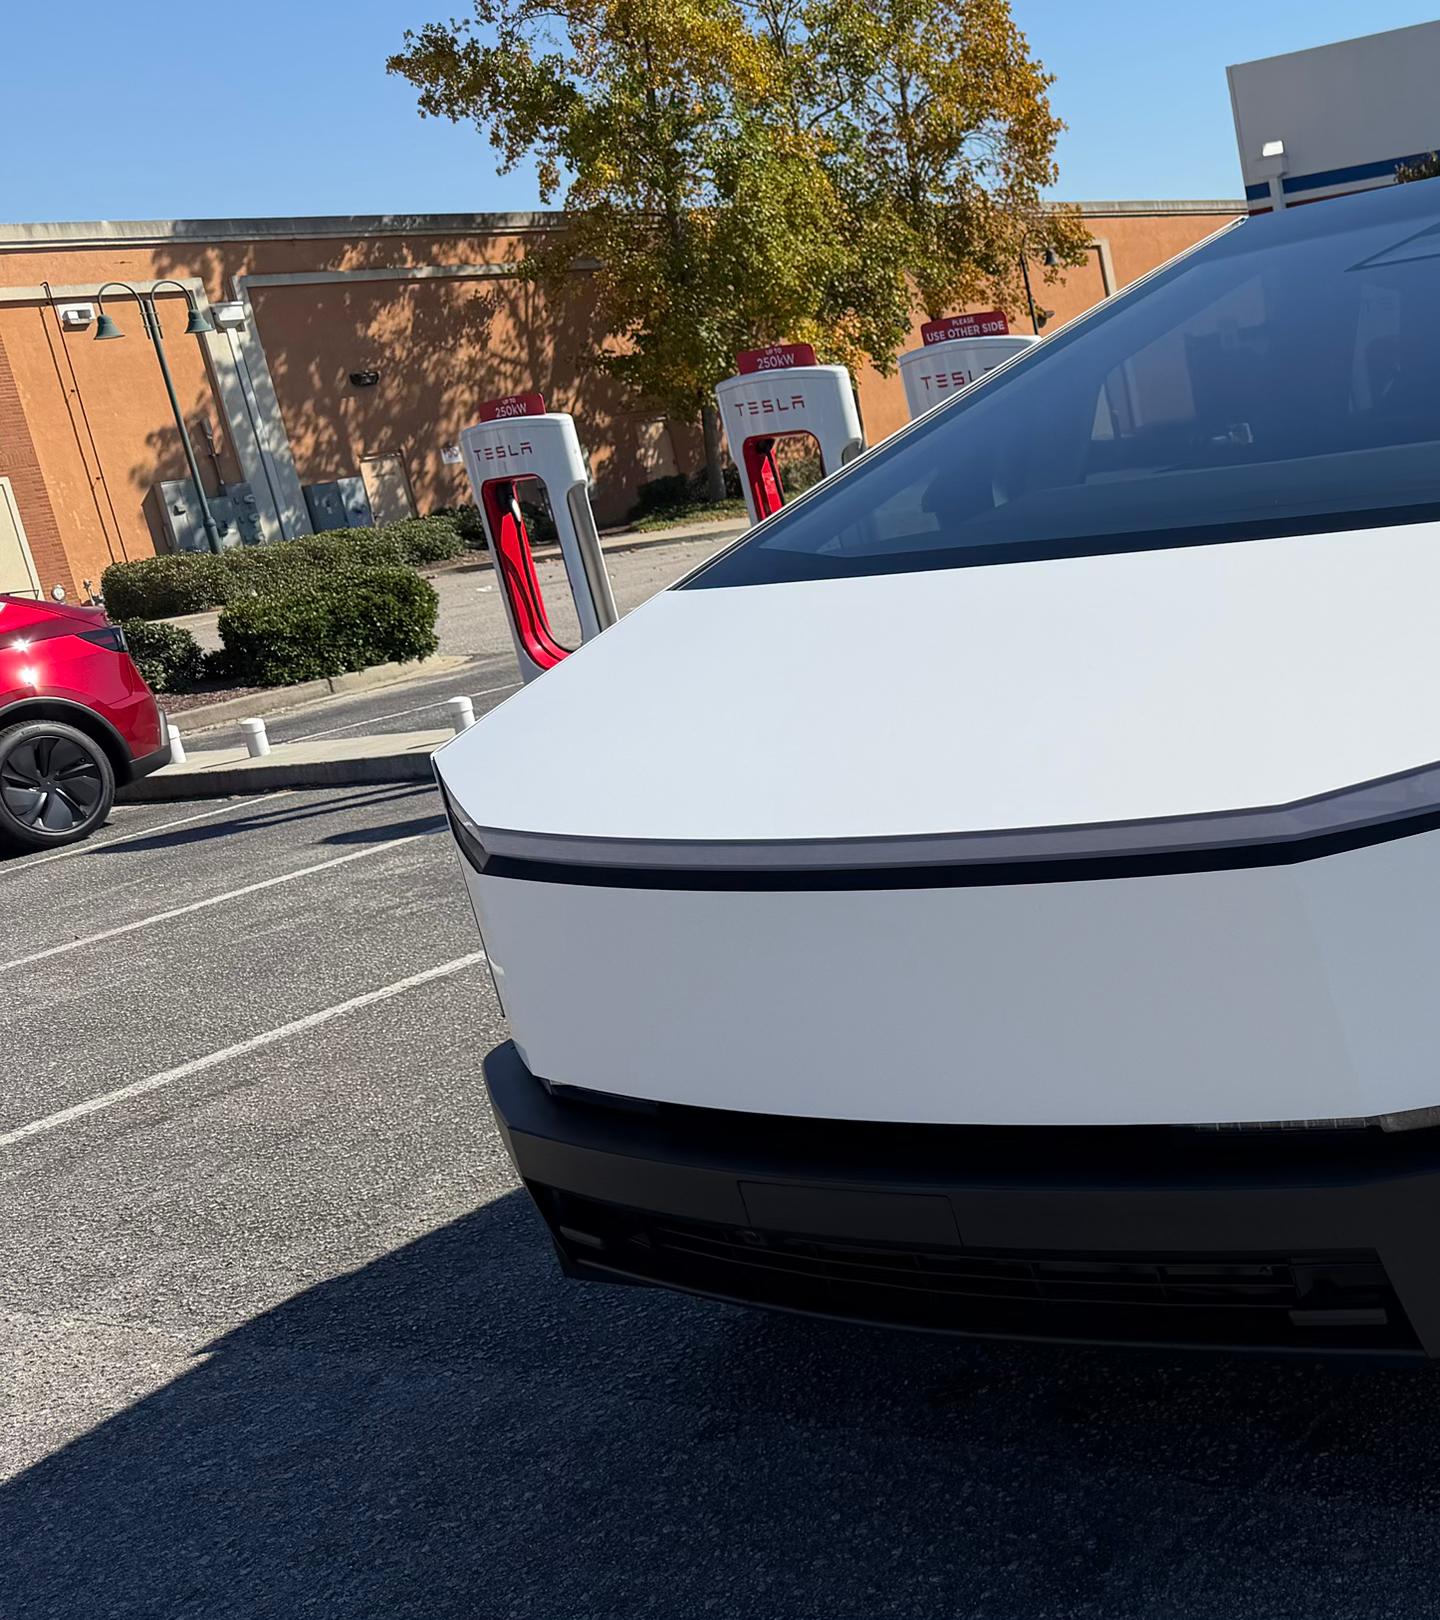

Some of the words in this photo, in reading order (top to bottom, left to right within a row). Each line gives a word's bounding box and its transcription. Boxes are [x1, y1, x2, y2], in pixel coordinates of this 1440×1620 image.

[926, 330, 946, 342] USE
[947, 325, 981, 339] OTHER
[982, 320, 1006, 333] SIDE
[951, 316, 975, 327] PLEASE
[756, 353, 795, 369] 250kW
[919, 366, 996, 390] TESL
[495, 402, 527, 418] 250kW
[734, 395, 806, 417] TESLA
[474, 442, 533, 461] TESLA
